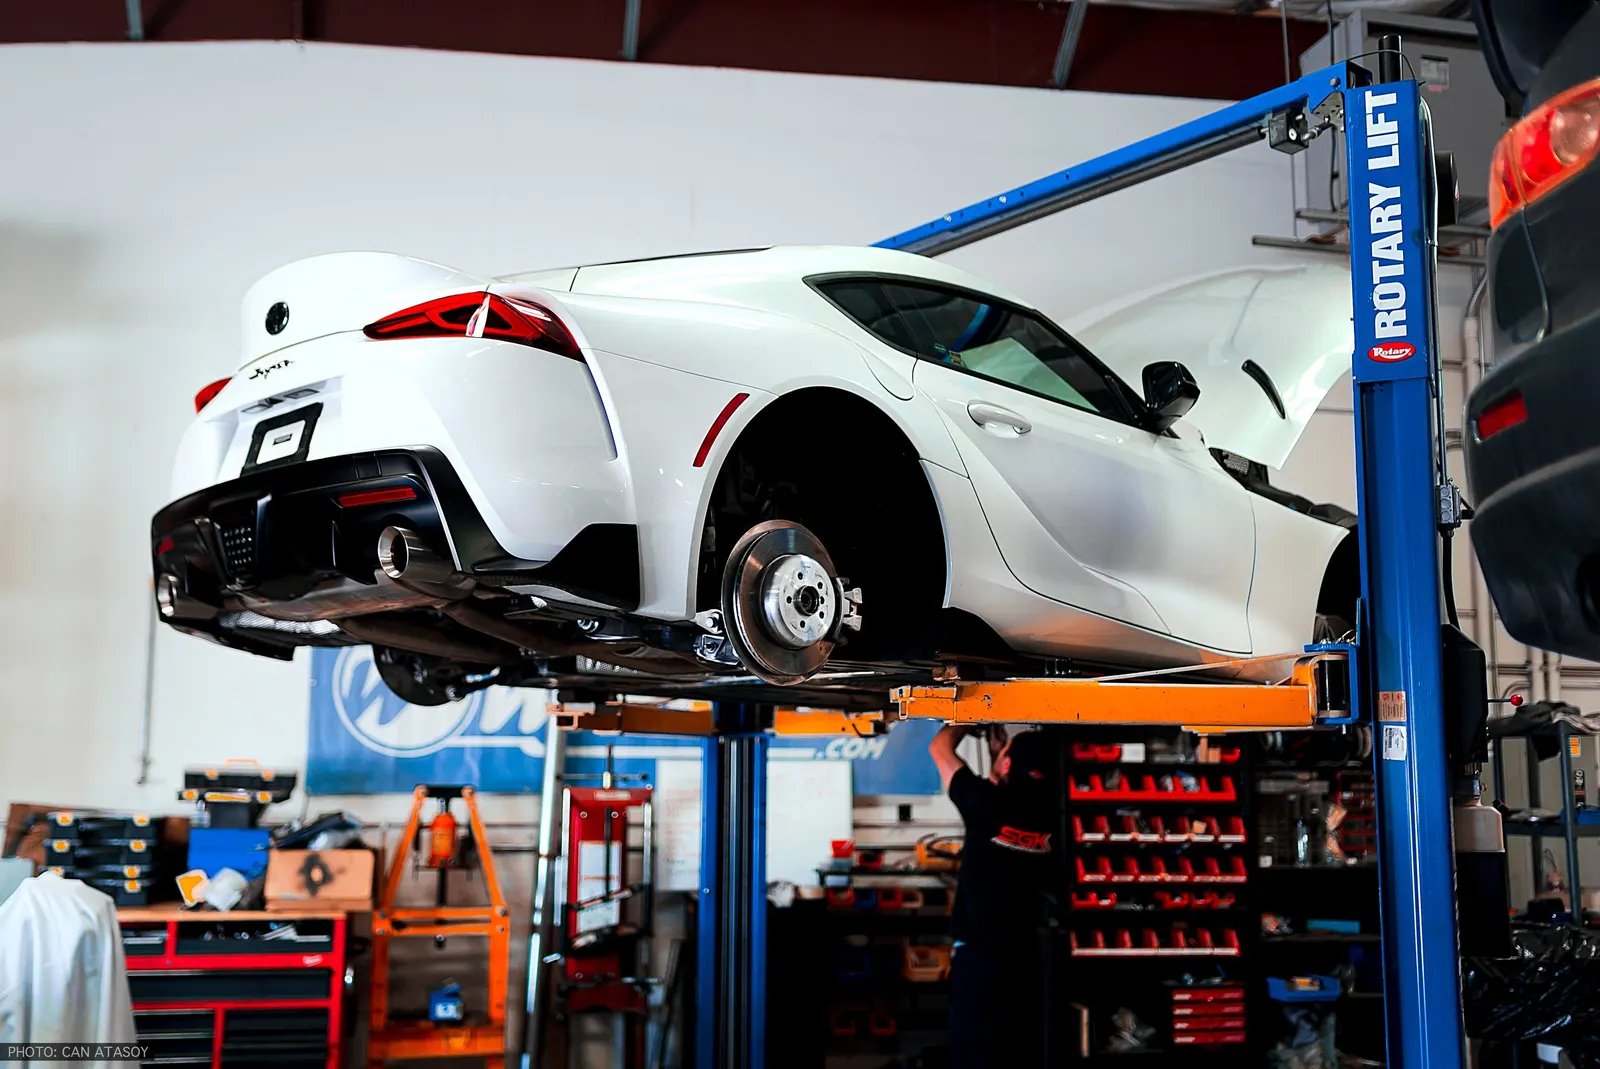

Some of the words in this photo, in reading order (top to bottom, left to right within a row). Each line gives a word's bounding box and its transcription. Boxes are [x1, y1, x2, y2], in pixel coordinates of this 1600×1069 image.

[1365, 90, 1400, 170] LIFT
[1368, 182, 1407, 339] ROTARY
[1373, 347, 1411, 359] Rotary
